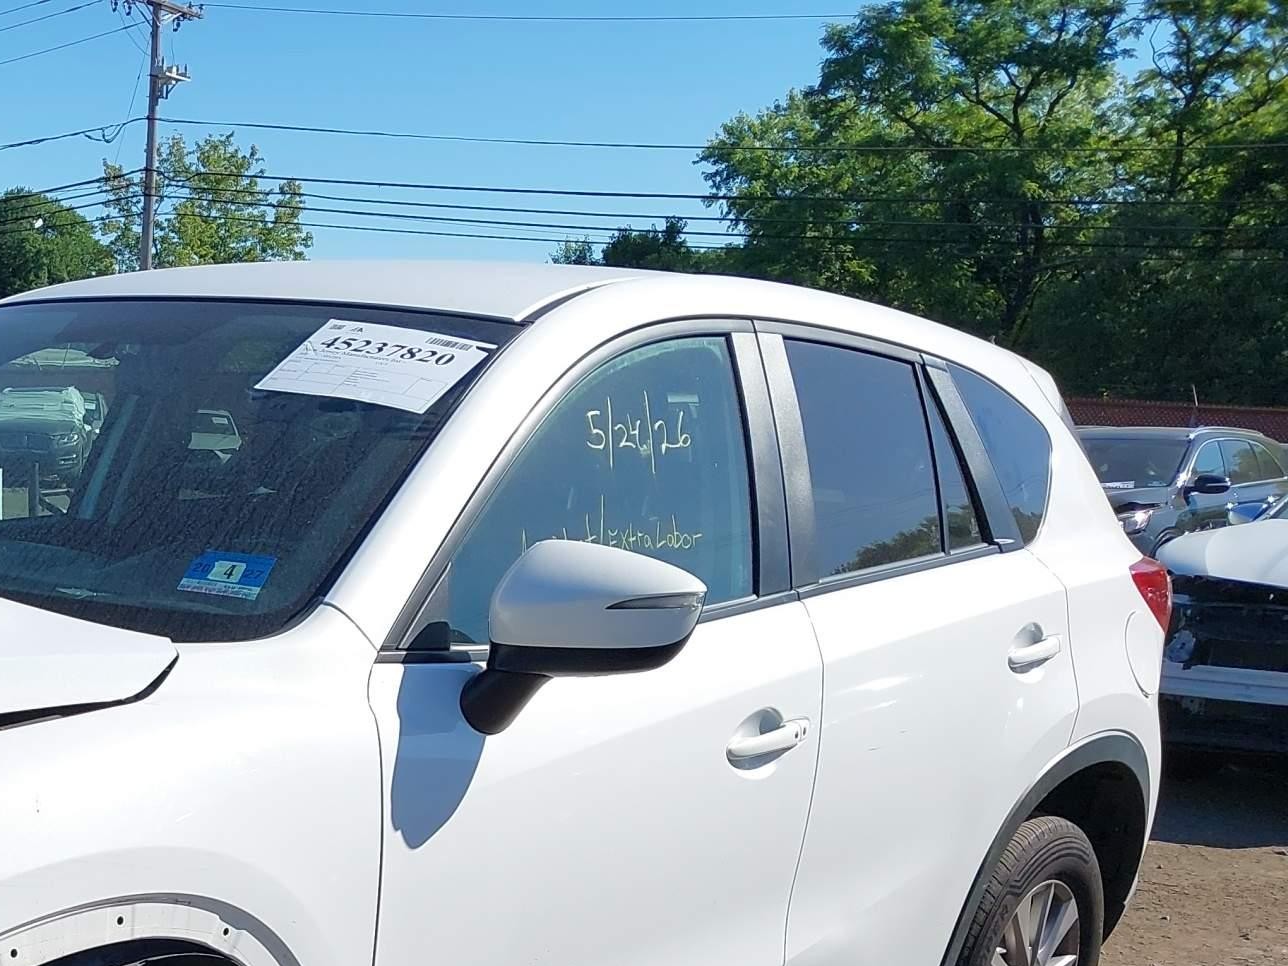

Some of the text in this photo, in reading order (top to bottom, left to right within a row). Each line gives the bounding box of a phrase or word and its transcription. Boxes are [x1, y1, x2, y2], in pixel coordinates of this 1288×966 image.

[320, 336, 456, 366] 45237820
[657, 513, 702, 549] Labor
[223, 564, 237, 580] 4
